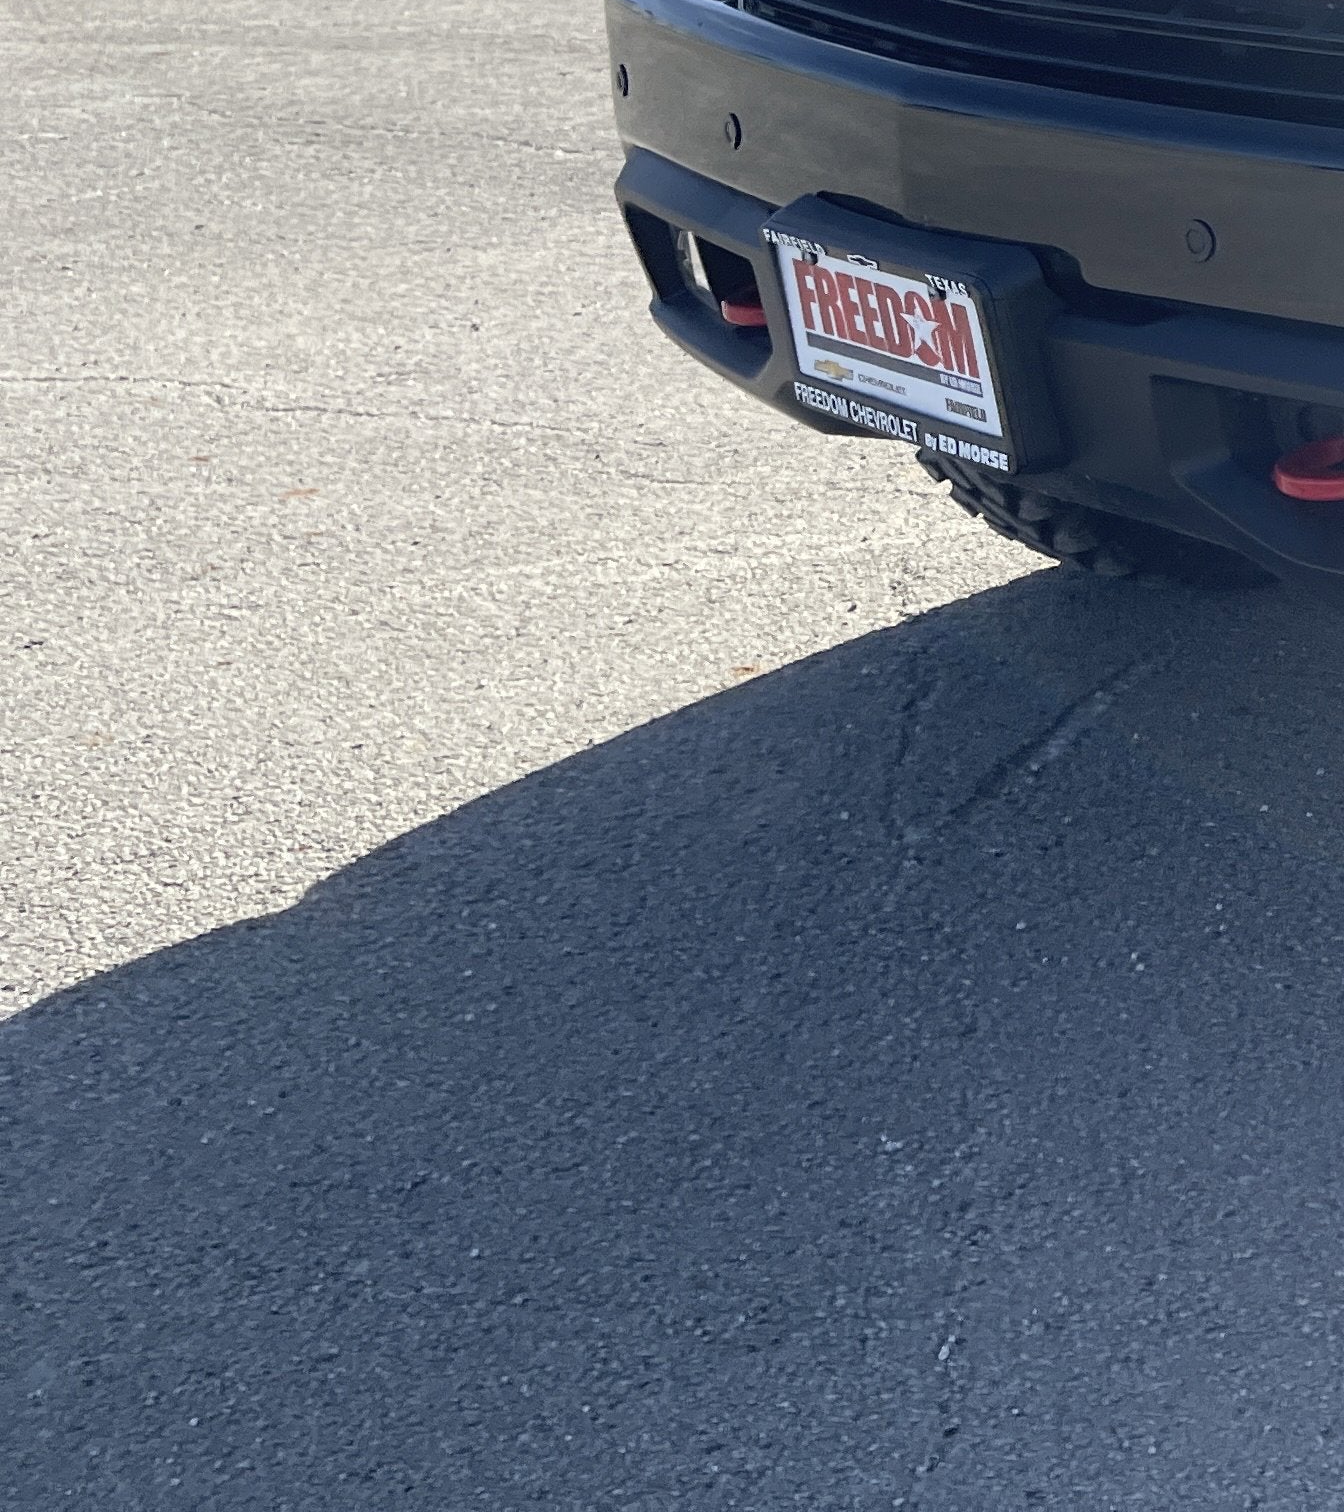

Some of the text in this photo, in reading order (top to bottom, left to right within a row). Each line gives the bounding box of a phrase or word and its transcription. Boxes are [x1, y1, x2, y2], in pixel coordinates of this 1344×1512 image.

[762, 228, 826, 256] FAIRFIELD
[925, 274, 969, 298] TEXAS
[792, 257, 981, 378] FREEDOM
[858, 374, 907, 396] CHEVROLET
[793, 381, 849, 419] FREEDOM
[850, 400, 919, 443] CHEVROLET
[938, 433, 957, 456] ED
[958, 441, 1010, 472] MORSE
